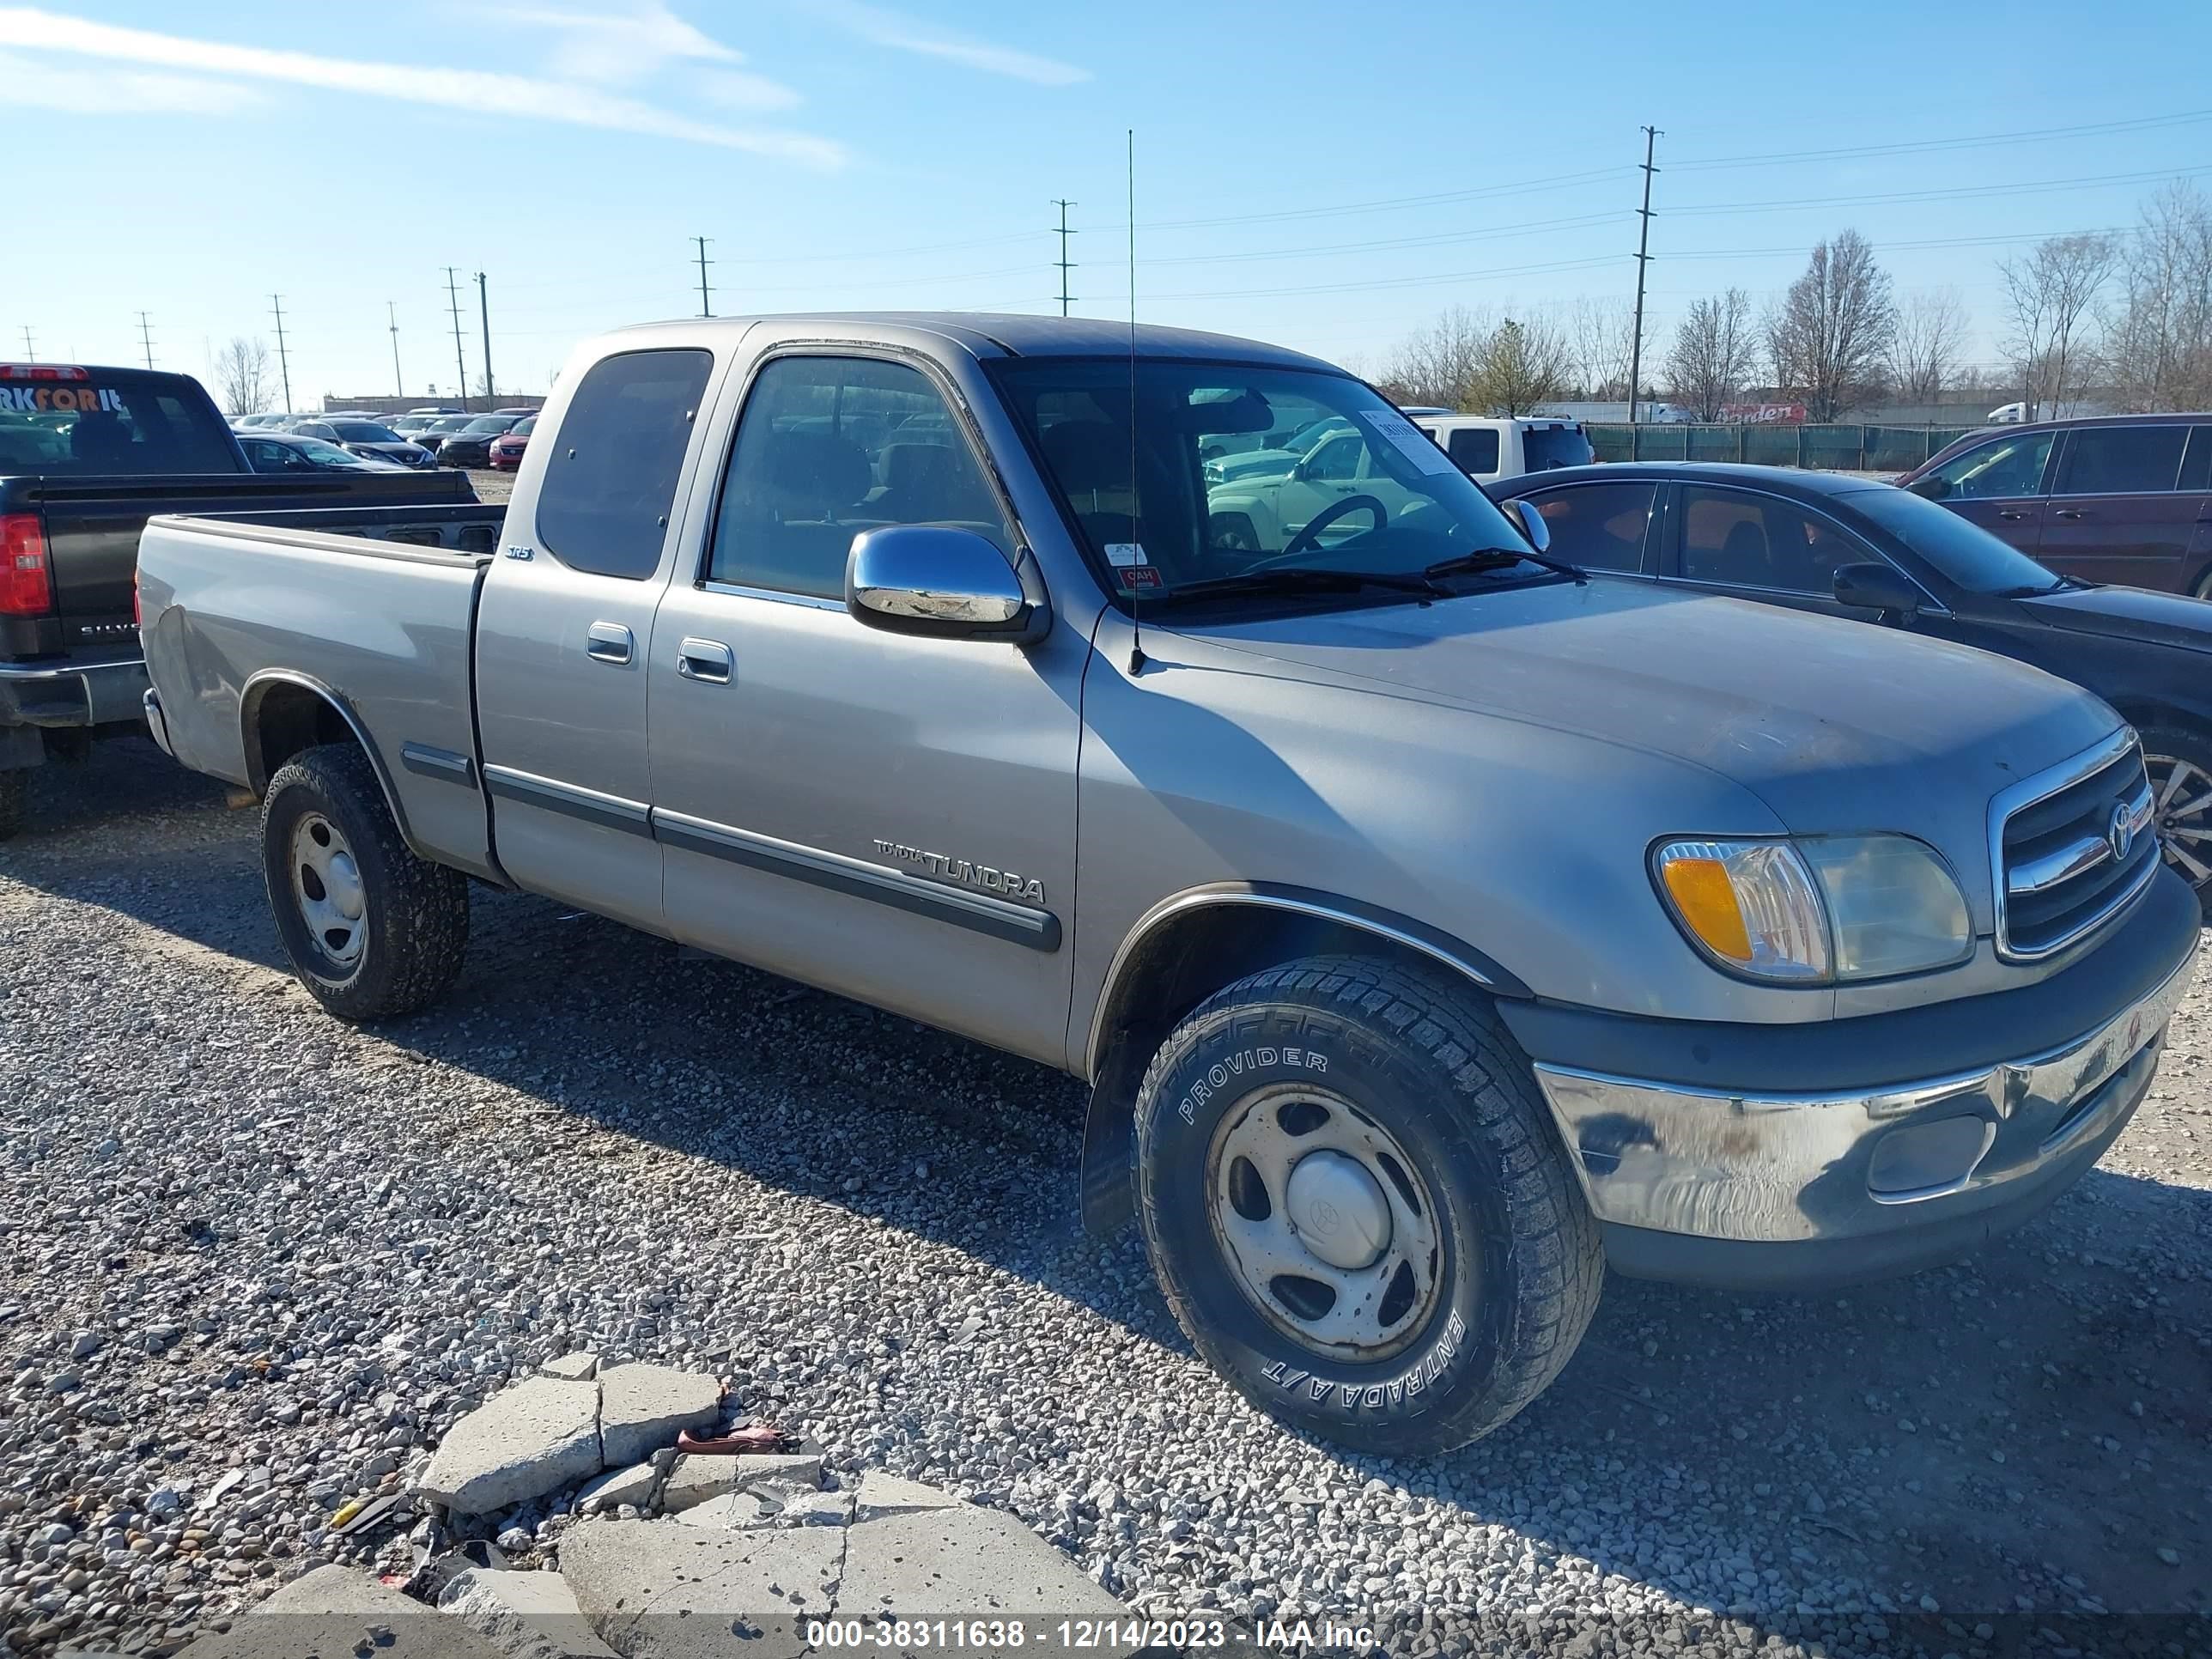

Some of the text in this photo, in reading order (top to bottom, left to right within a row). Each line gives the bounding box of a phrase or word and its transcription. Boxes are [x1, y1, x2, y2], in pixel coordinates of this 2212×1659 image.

[873, 839, 1046, 904] TOYOTA TUNDRA
[1179, 1047, 1328, 1126] PROVIDER
[1261, 1308, 1466, 1408] ENTRADA A/T
